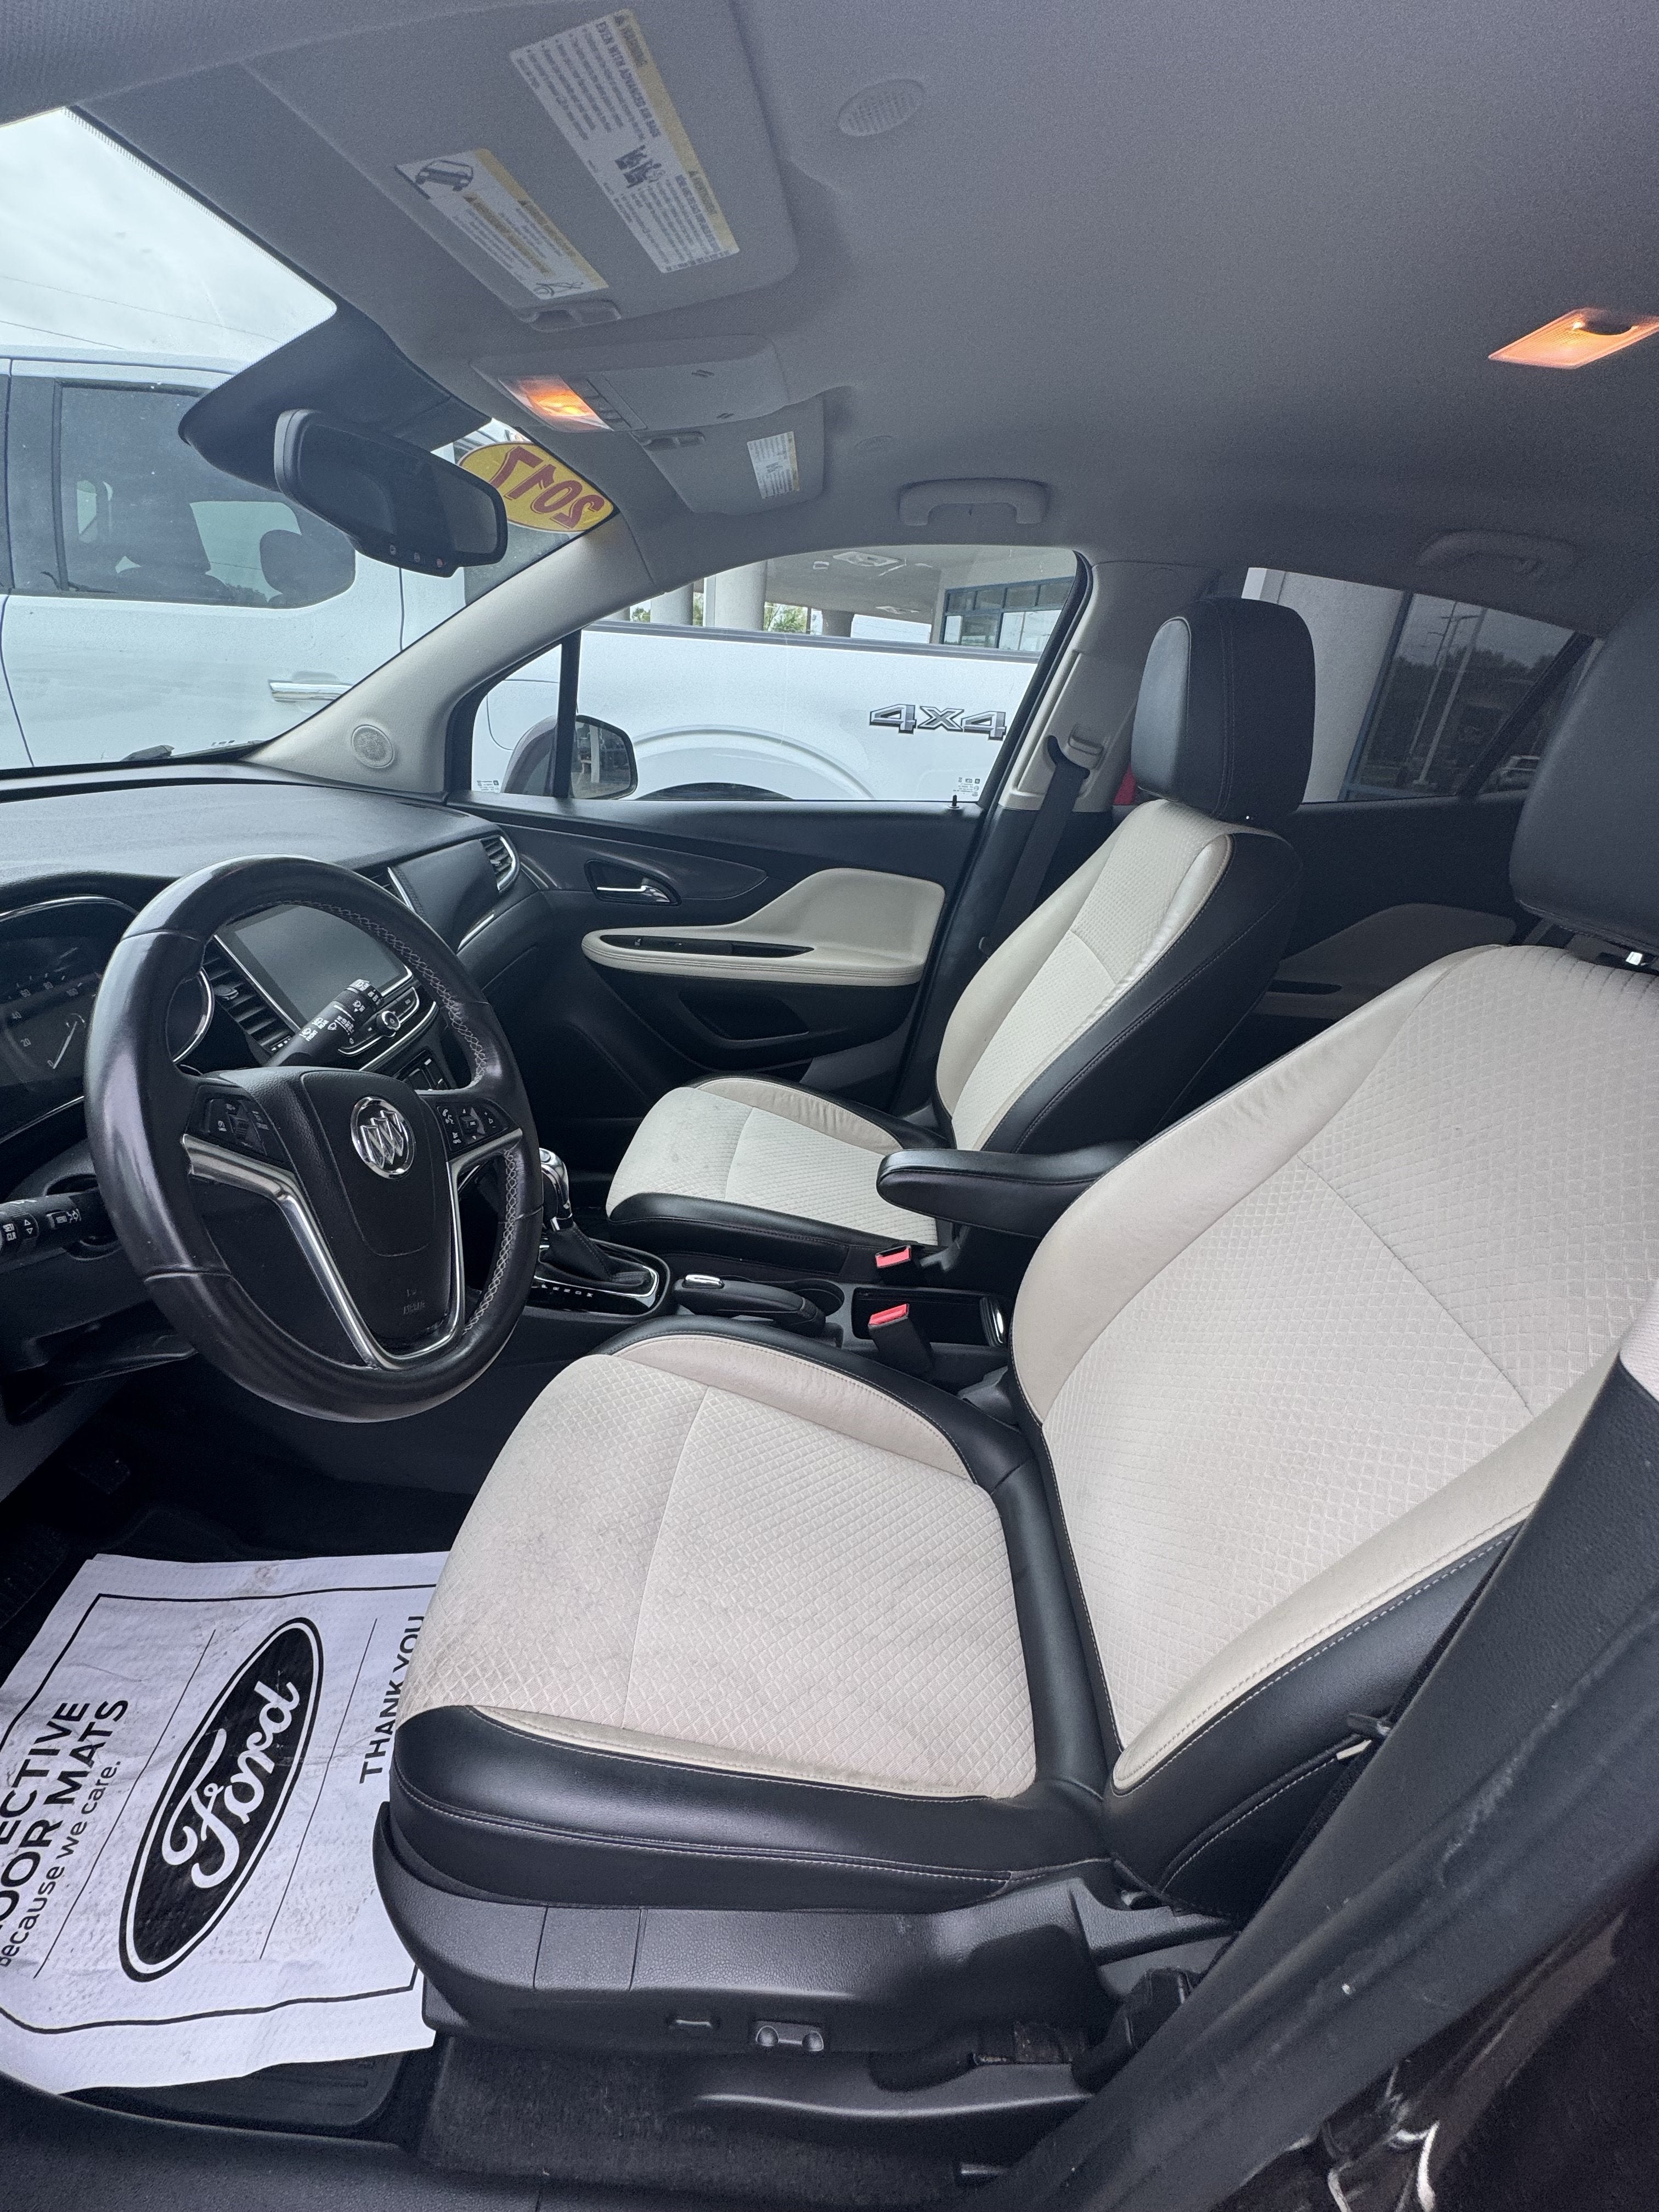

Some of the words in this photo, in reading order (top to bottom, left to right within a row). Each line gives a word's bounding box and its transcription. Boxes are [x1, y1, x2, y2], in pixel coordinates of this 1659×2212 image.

[20, 1038, 31, 1047] 20
[306, 1030, 318, 1041] FRONT
[359, 1679, 404, 1784] THANK
[392, 1616, 425, 1673] YOU
[43, 1700, 128, 1805] MATS
[162, 1680, 300, 1889] Ford
[56, 1821, 87, 1861] we
[81, 1760, 121, 1815] care.
